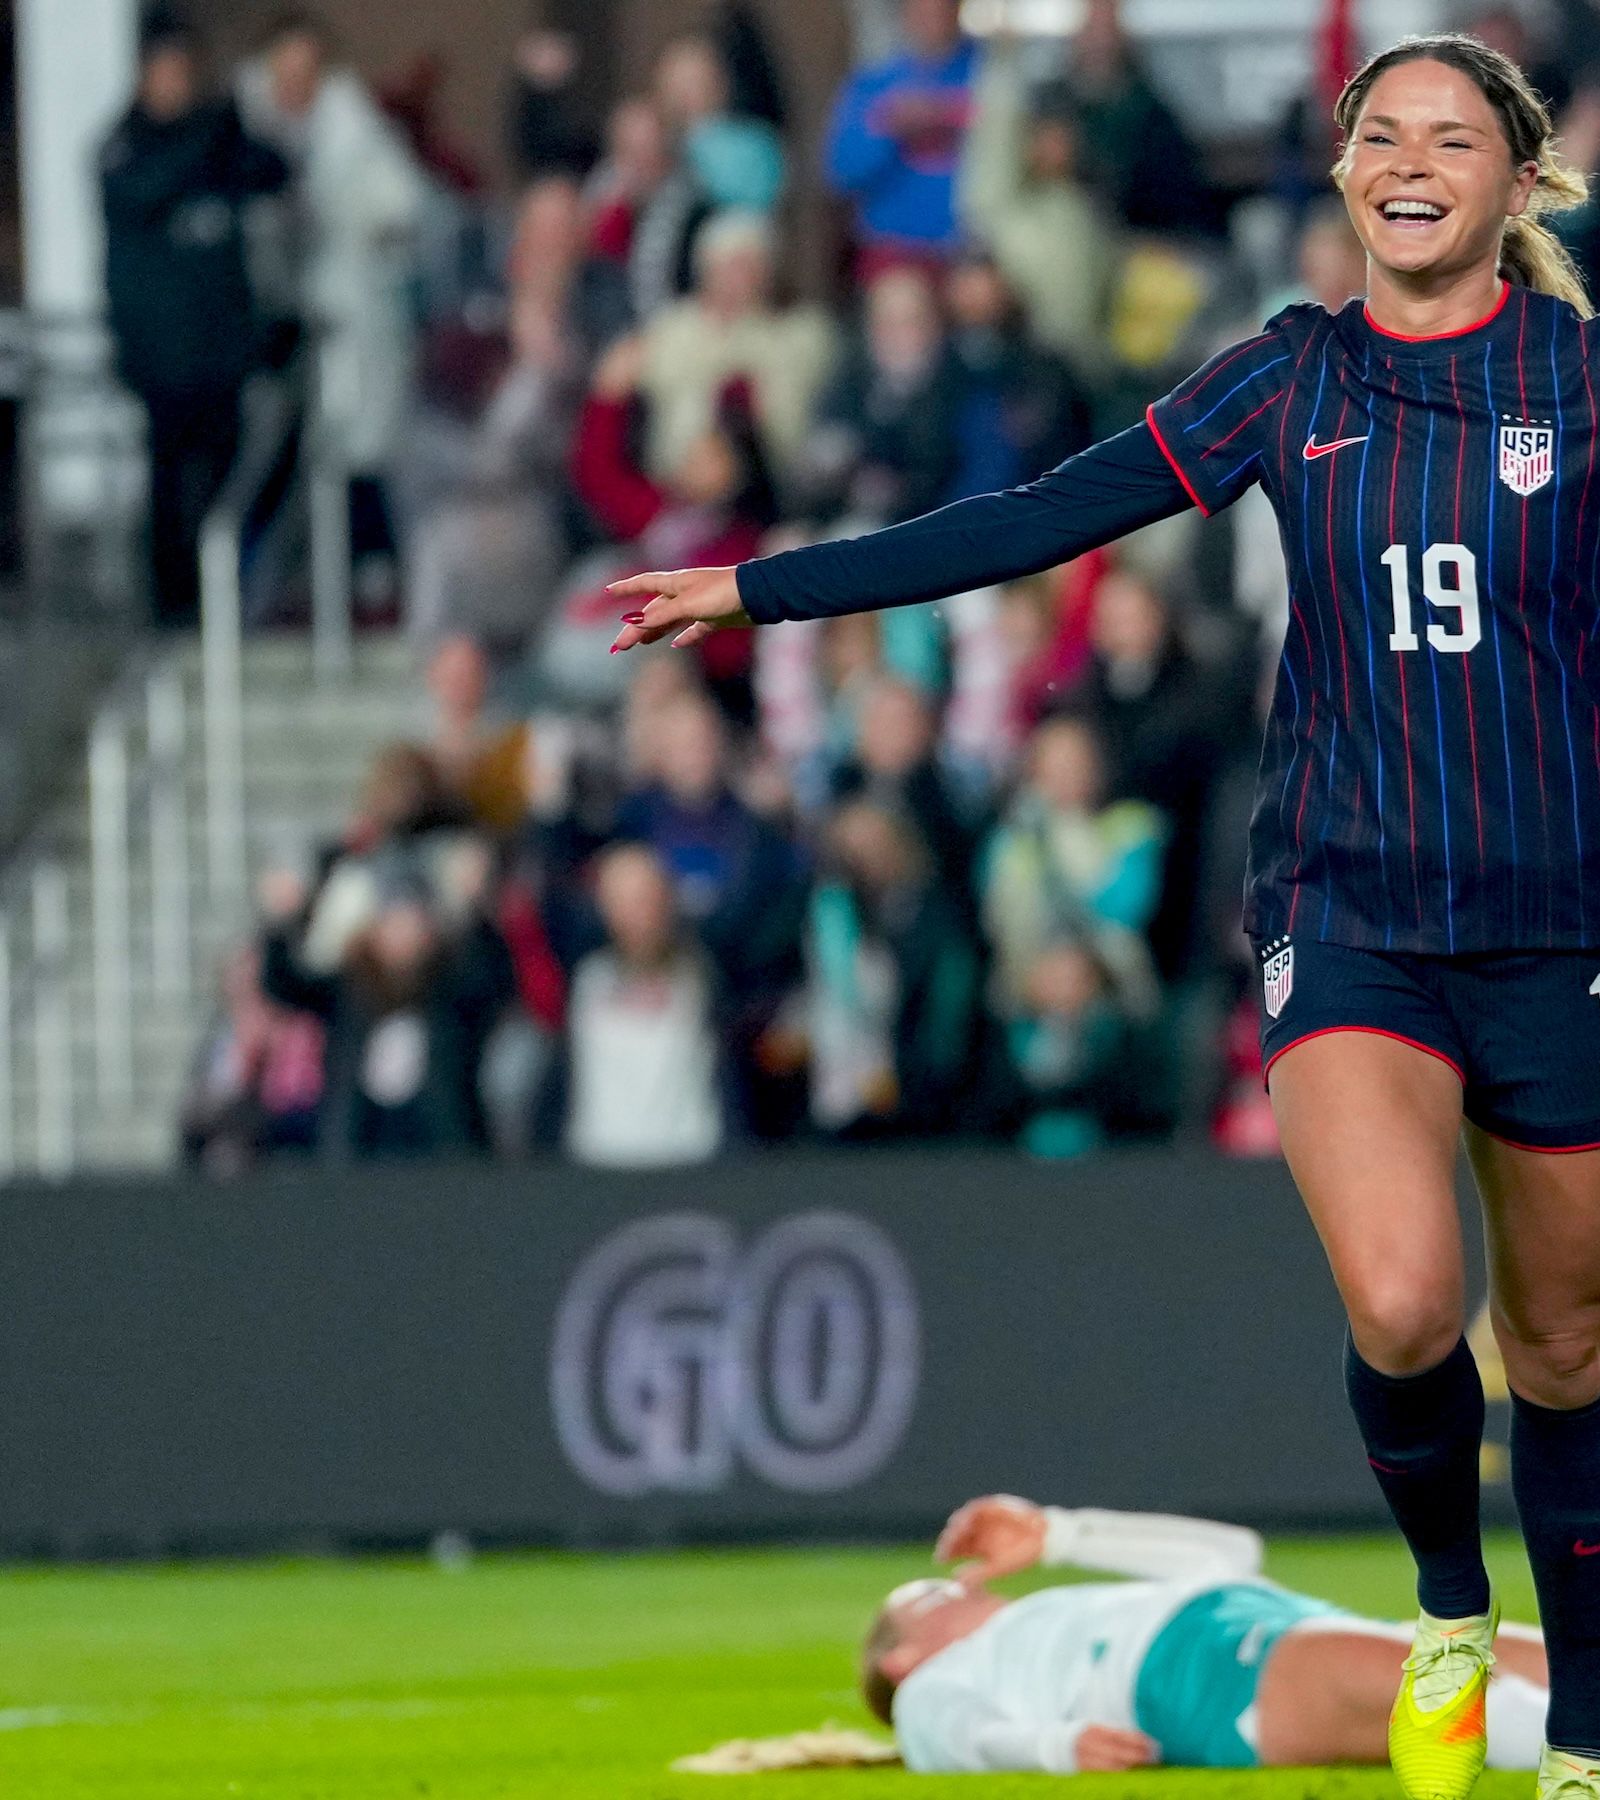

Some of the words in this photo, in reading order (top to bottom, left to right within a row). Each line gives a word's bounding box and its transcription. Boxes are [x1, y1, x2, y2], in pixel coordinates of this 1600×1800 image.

[1504, 430, 1549, 457] USA
[1380, 543, 1482, 653] 19
[1265, 951, 1291, 982] USA
[551, 1208, 921, 1496] GO
